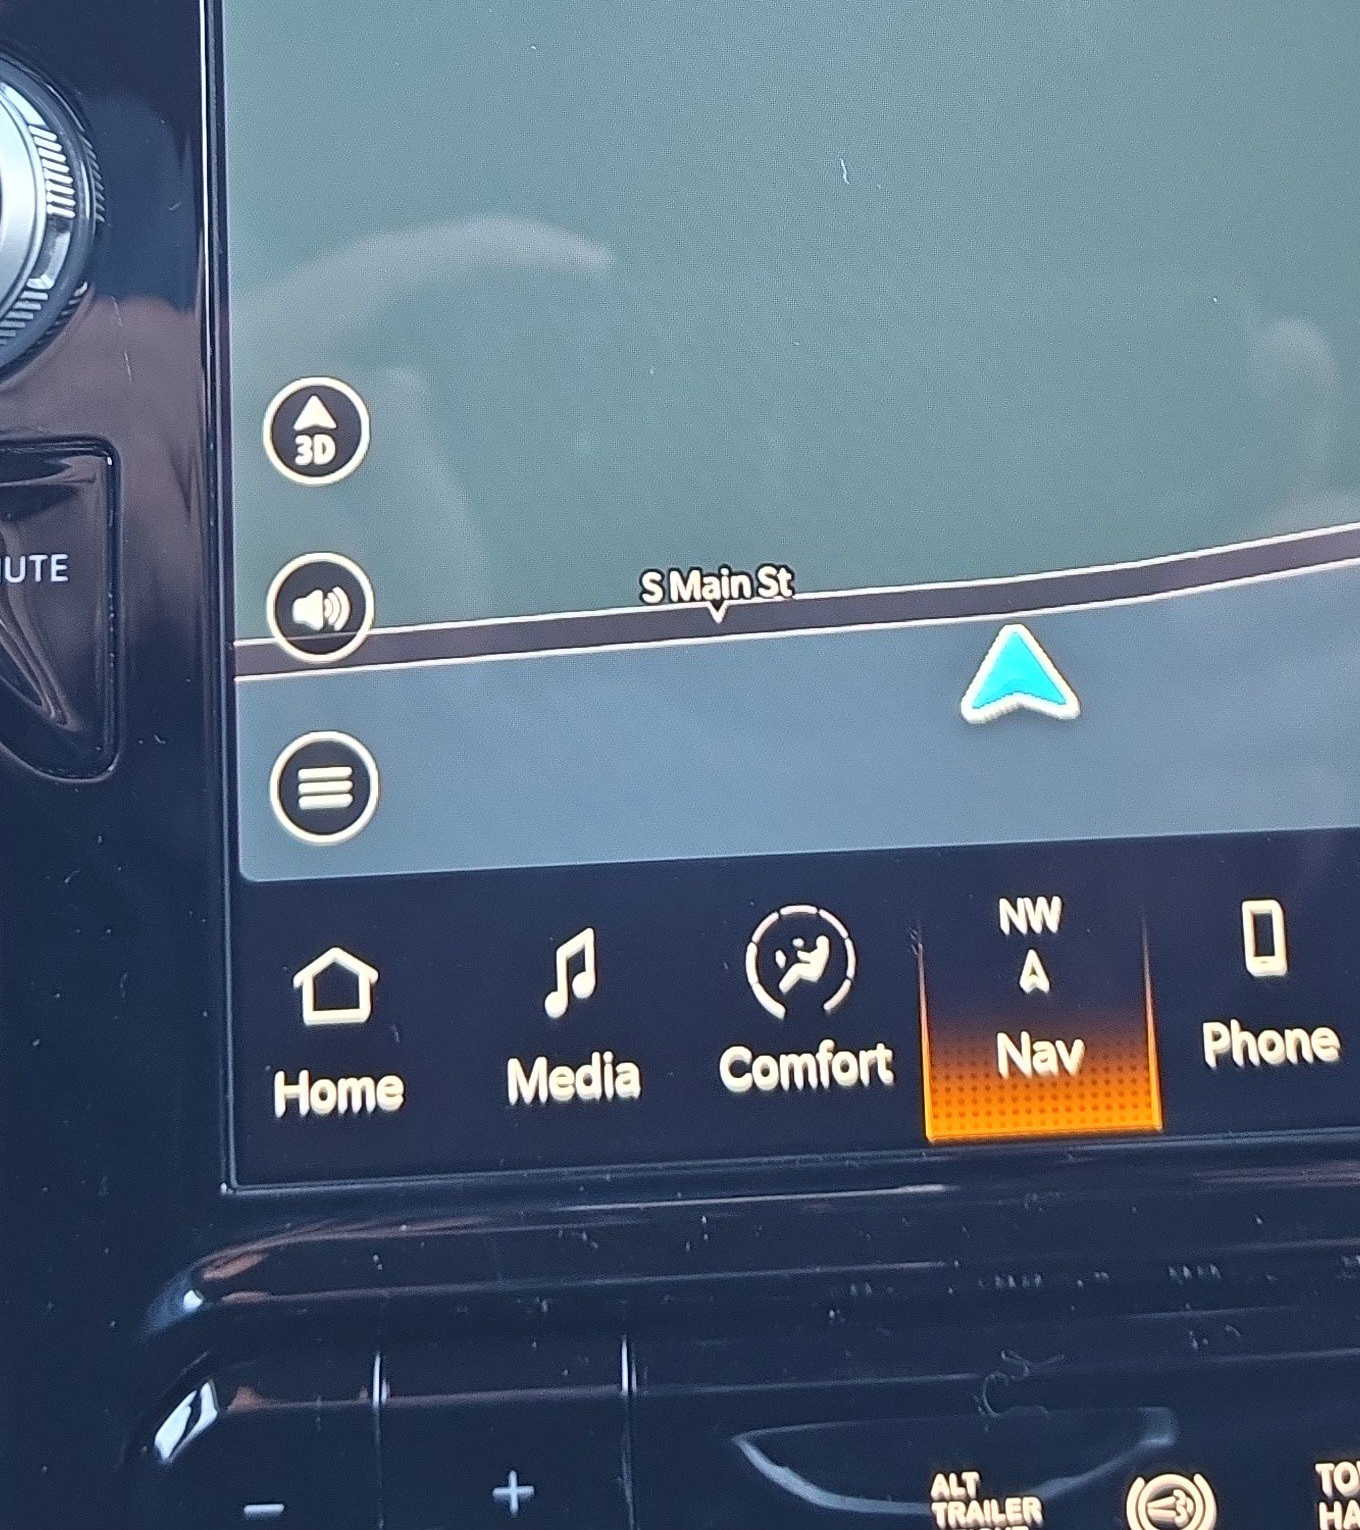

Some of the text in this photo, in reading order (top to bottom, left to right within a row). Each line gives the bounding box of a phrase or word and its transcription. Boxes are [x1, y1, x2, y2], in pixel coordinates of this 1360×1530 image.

[293, 433, 337, 466] 3D
[641, 565, 794, 604] S Main St
[998, 895, 1064, 936] NW
[718, 1038, 895, 1092] Comfort
[996, 1030, 1086, 1079] Nav
[1202, 1018, 1341, 1069] Phone
[273, 1069, 406, 1118] Home
[507, 1050, 641, 1107] Media
[930, 1471, 981, 1501] ALT
[931, 1496, 1045, 1530] TRAILER
